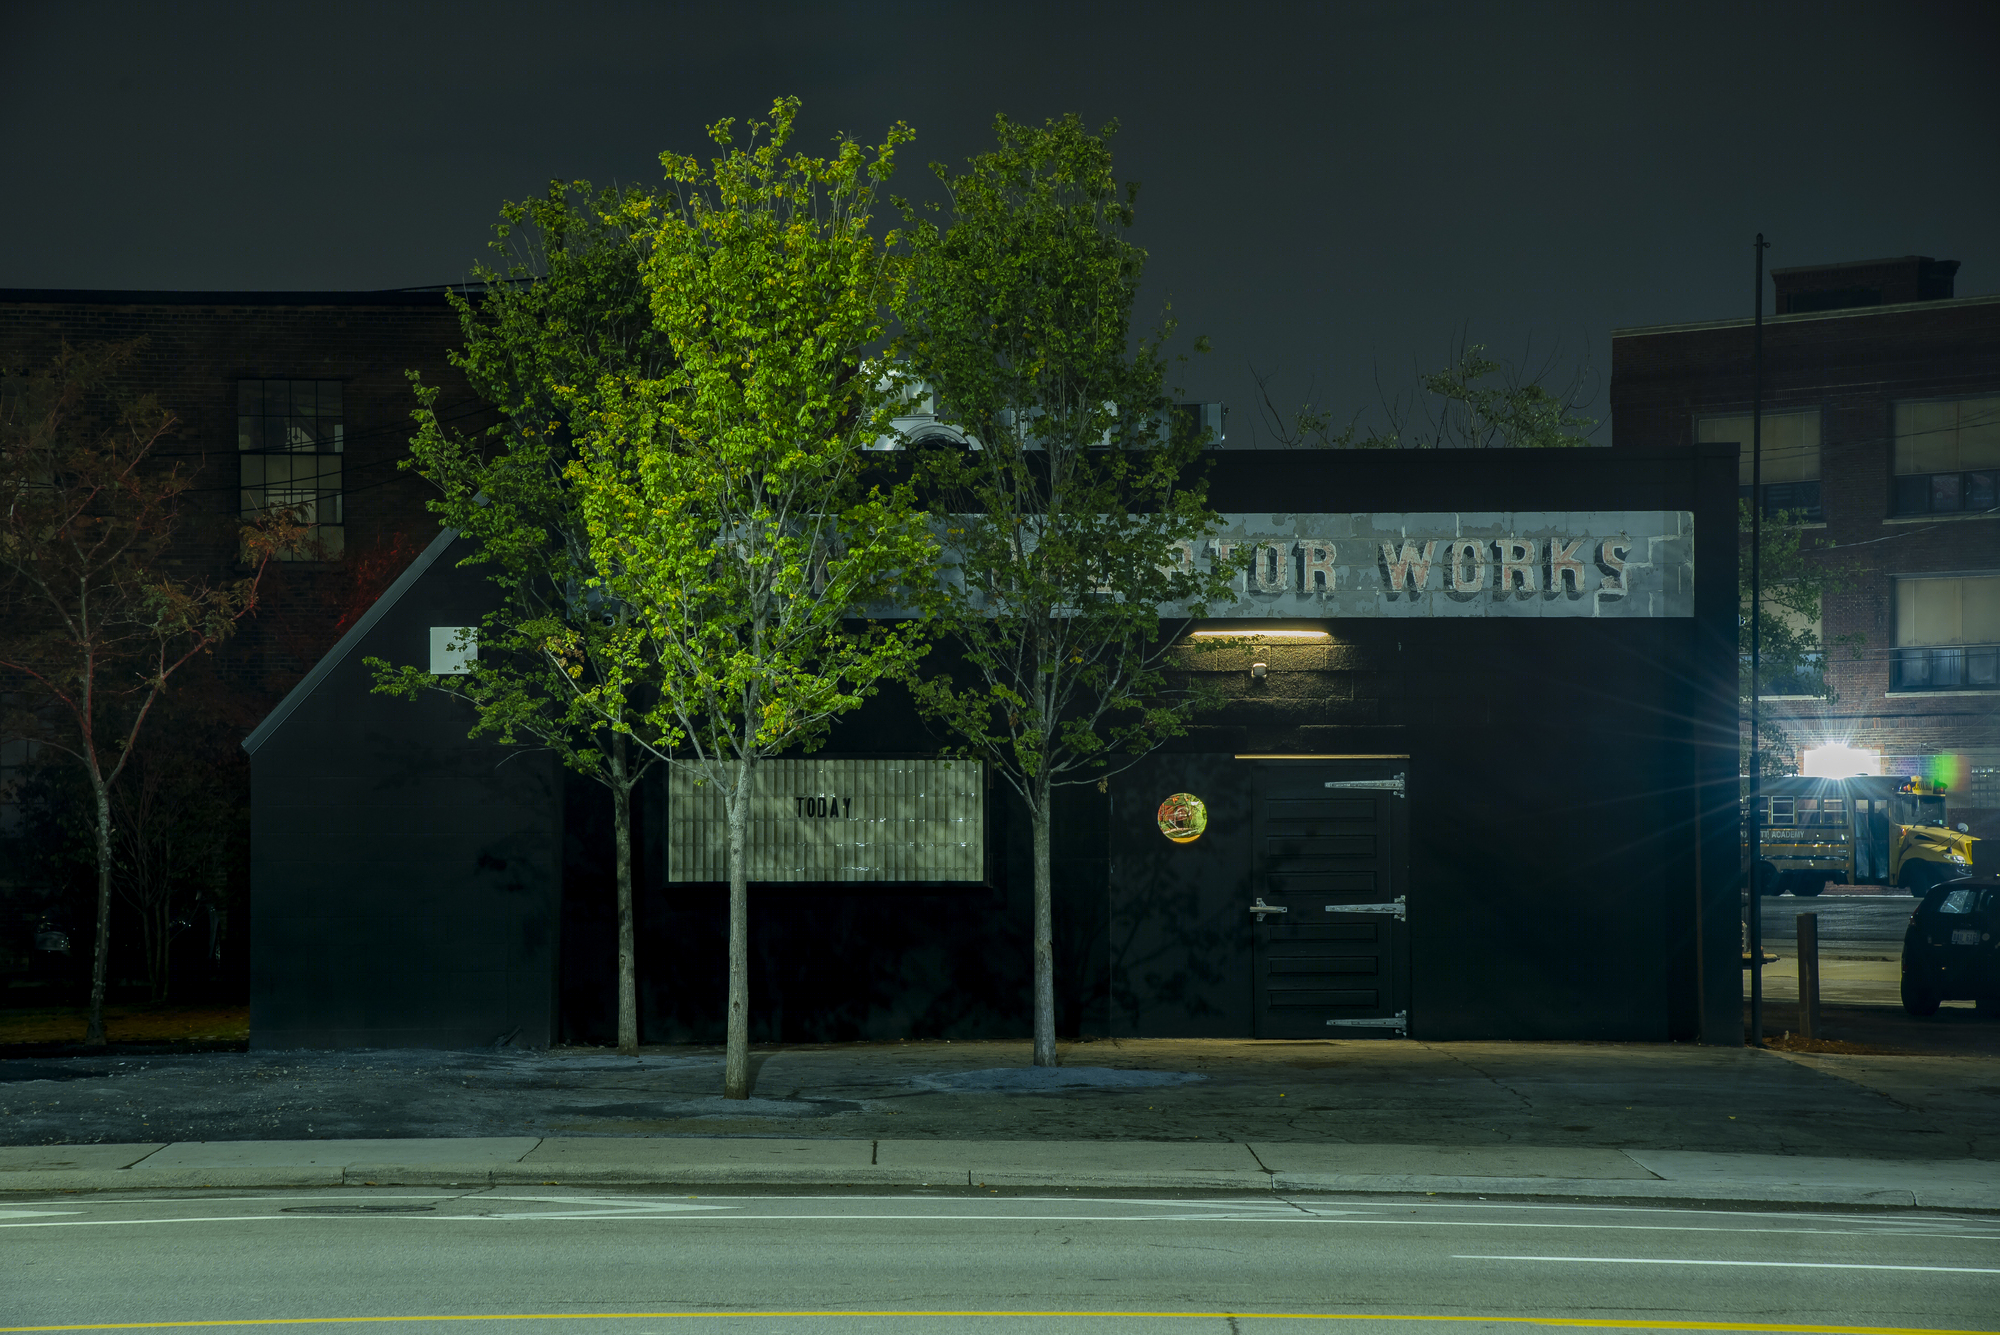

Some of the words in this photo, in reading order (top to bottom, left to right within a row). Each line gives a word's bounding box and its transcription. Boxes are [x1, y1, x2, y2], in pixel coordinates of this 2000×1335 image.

[1379, 537, 1634, 600] WORKS
[796, 797, 851, 818] TODAY
[1771, 830, 1805, 838] ACADEMY
